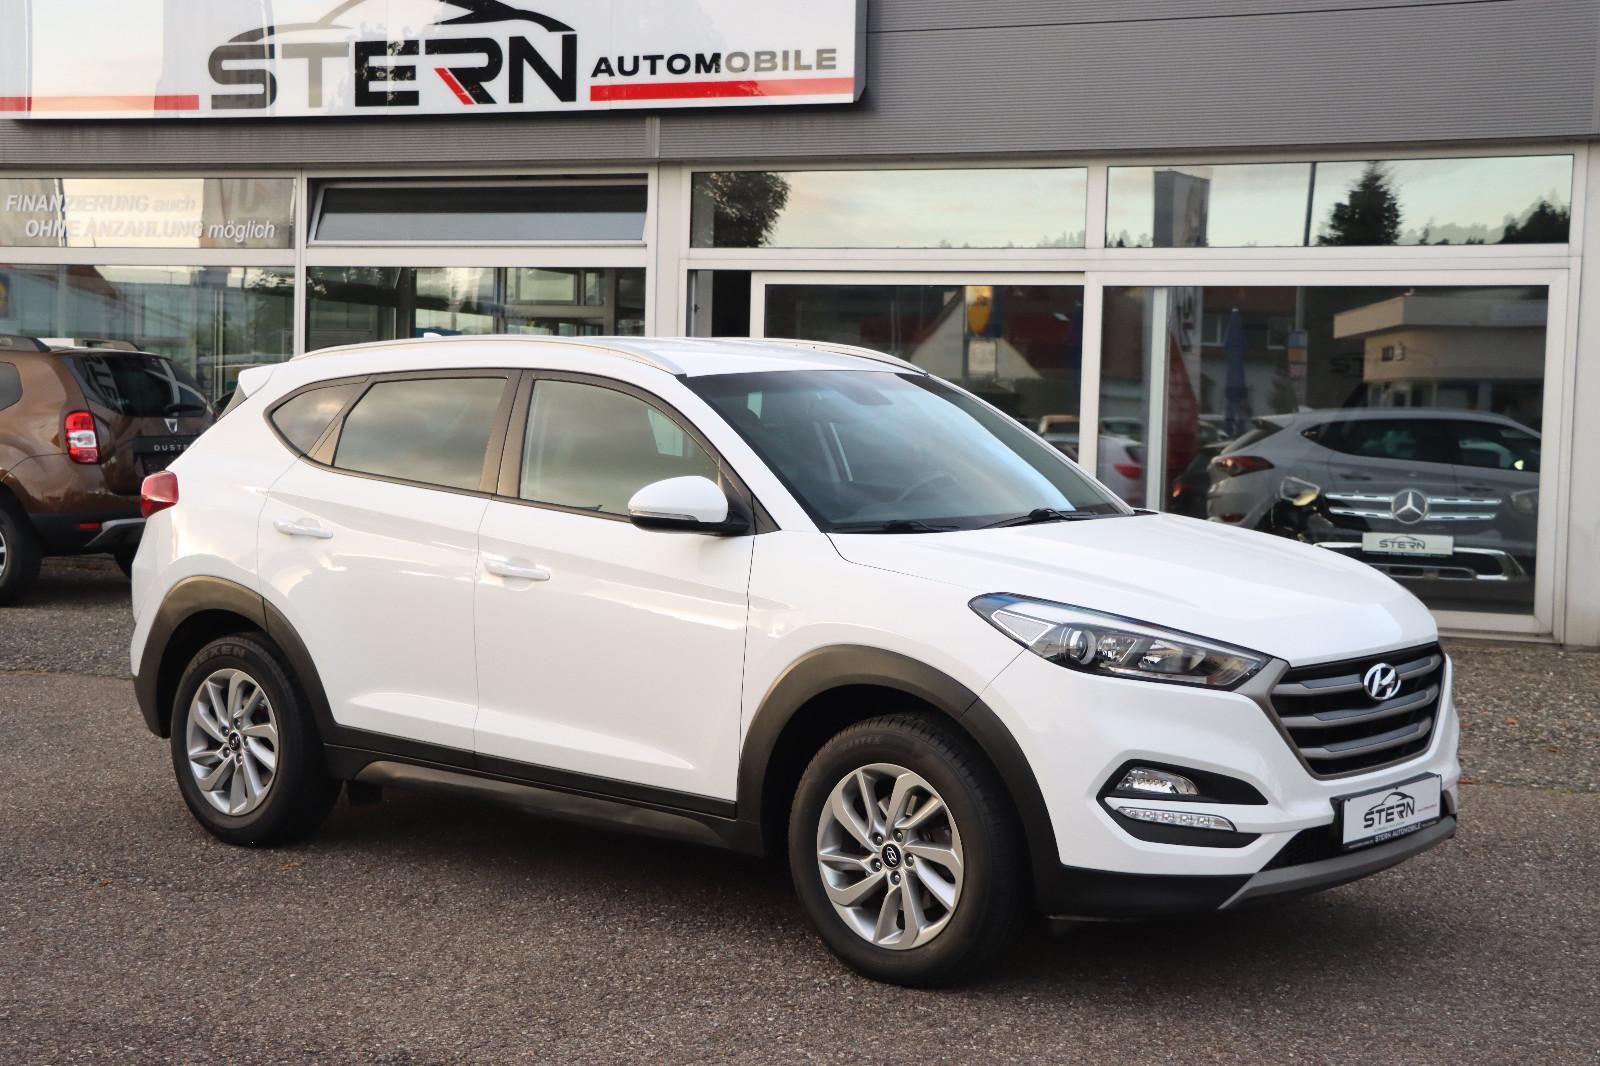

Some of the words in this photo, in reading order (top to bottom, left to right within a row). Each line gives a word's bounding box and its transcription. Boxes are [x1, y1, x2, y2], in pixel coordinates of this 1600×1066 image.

[208, 34, 577, 110] STERN
[590, 48, 837, 78] AUTOMOBILE
[6, 194, 149, 212] FINANZIERUNG
[25, 219, 80, 237] OHNE
[83, 219, 204, 238] ANZAHLUNG
[208, 220, 276, 243] möglich
[1379, 540, 1426, 551] STERN
[1364, 801, 1415, 828] STERN
[1375, 832, 1392, 842] STERN
